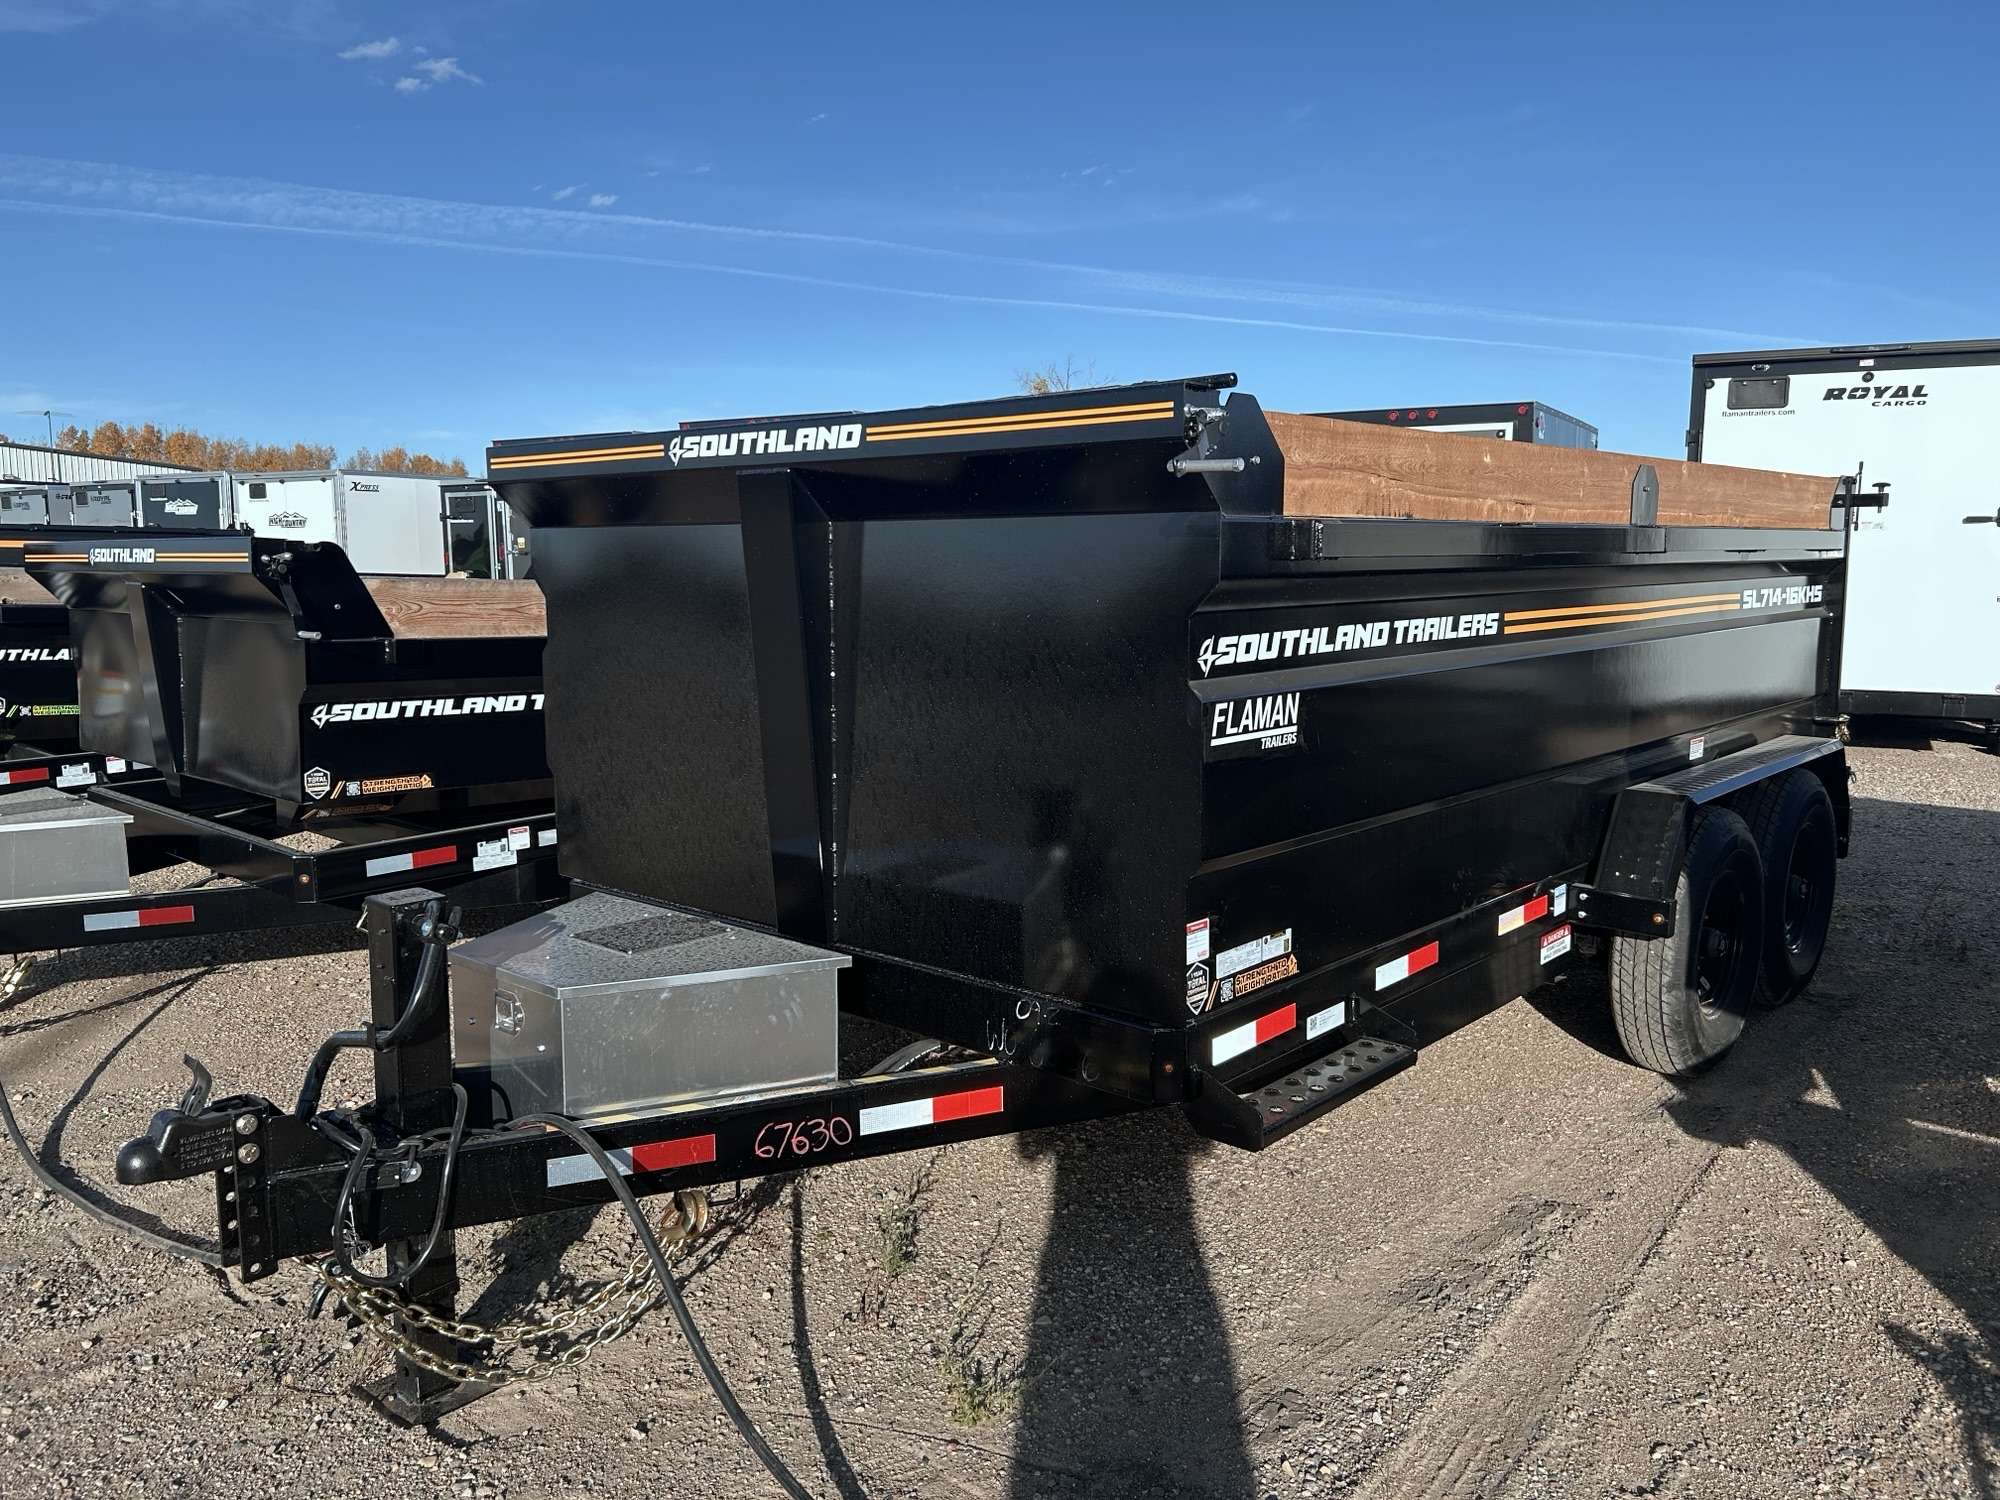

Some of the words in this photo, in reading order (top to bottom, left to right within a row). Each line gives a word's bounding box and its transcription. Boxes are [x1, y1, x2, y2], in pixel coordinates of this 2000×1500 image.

[1822, 385, 1928, 400] ROYAL
[681, 424, 863, 458] SOUTHLAND
[94, 548, 155, 563] SOUTHLAND
[1743, 585, 1823, 609] SL714-16KHS
[1215, 621, 1390, 666] SOUTHLAND
[1394, 612, 1499, 644] TRAILERS
[329, 695, 527, 721] SOUTHLAND
[1212, 692, 1300, 737] FLAMAN
[1261, 733, 1297, 749] TRAILERS
[364, 785, 396, 794] WEIGHT
[1188, 975, 1206, 989] TOTAL
[1236, 965, 1276, 986] STRENGTH
[1236, 977, 1267, 995] WEIGHT
[1267, 968, 1287, 982] RATIO
[755, 1117, 852, 1158] 67630
